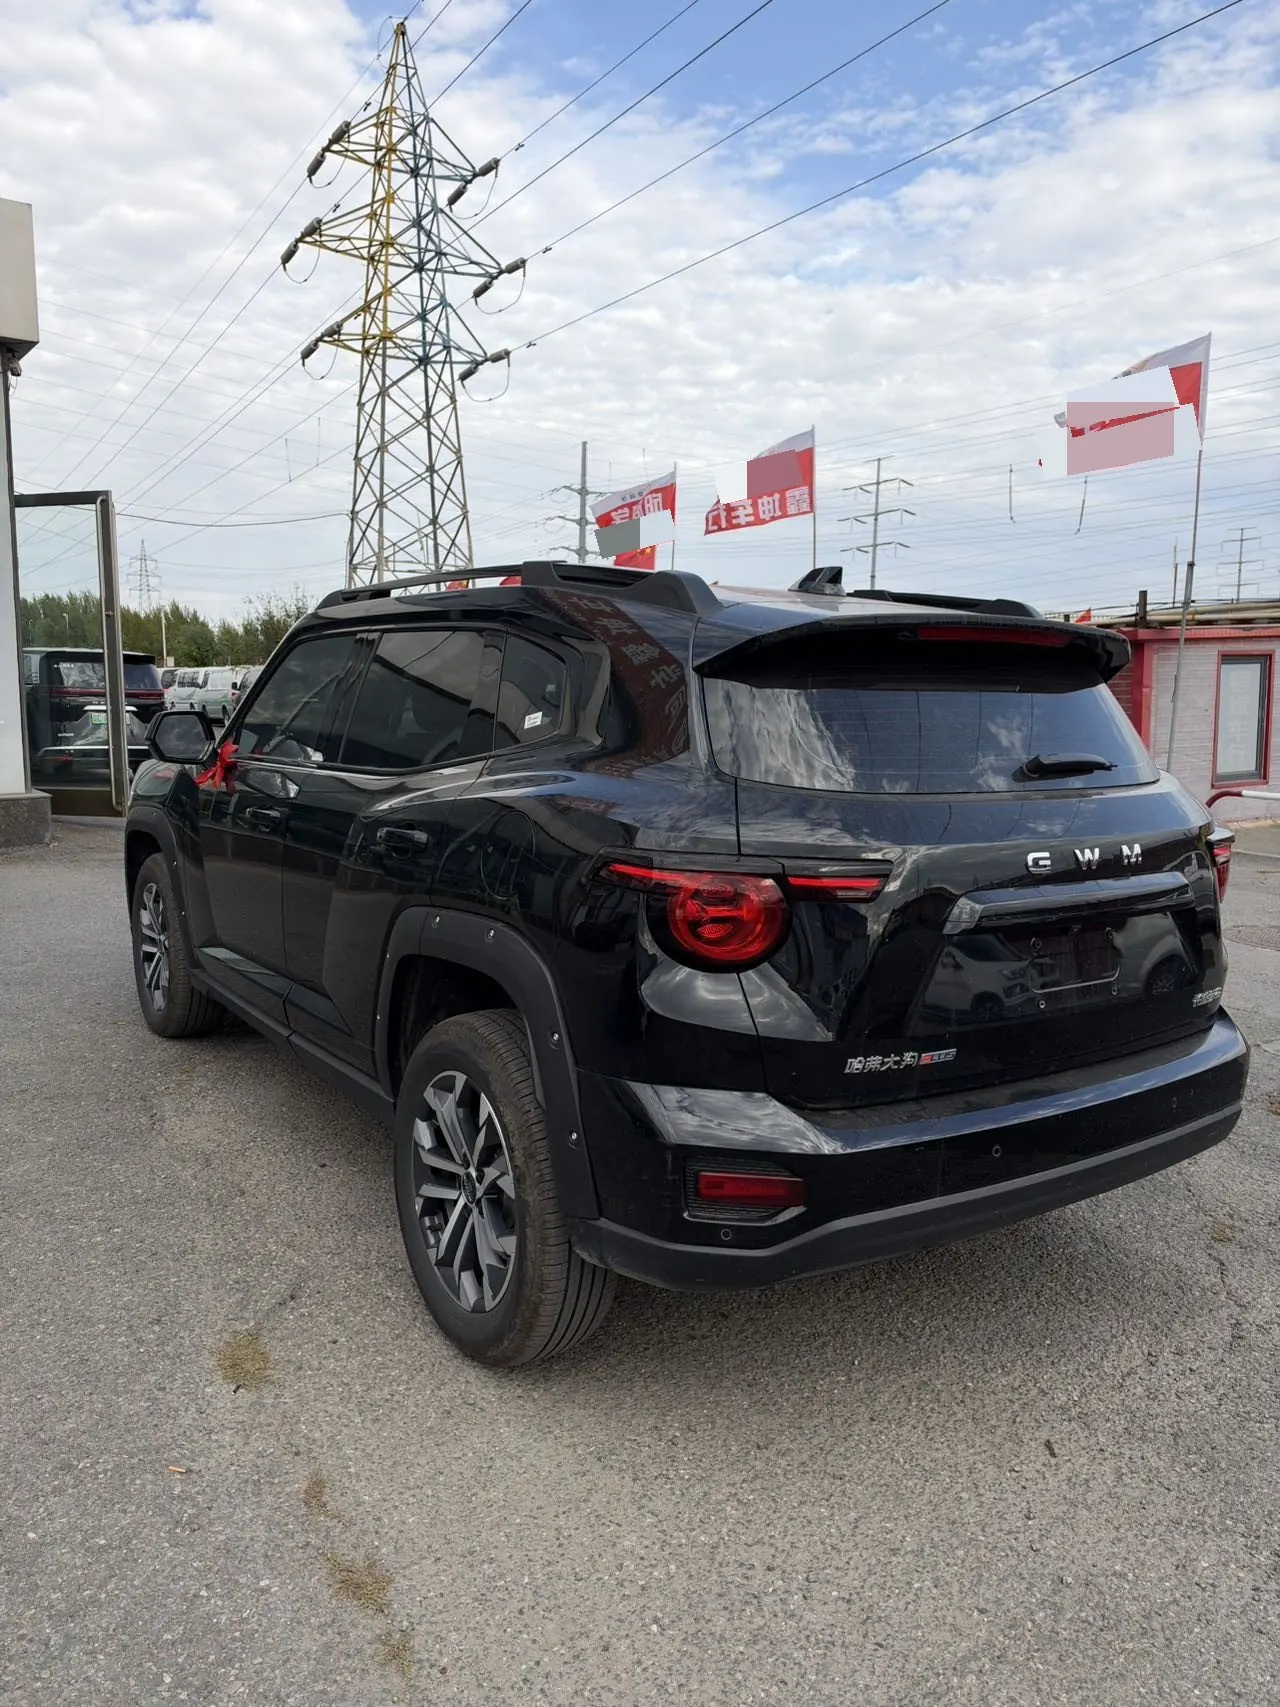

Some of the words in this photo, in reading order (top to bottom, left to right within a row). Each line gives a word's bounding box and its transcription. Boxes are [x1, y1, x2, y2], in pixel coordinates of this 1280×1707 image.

[1026, 843, 1143, 874] GWM
[844, 1051, 919, 1074] 哈弗大狗
